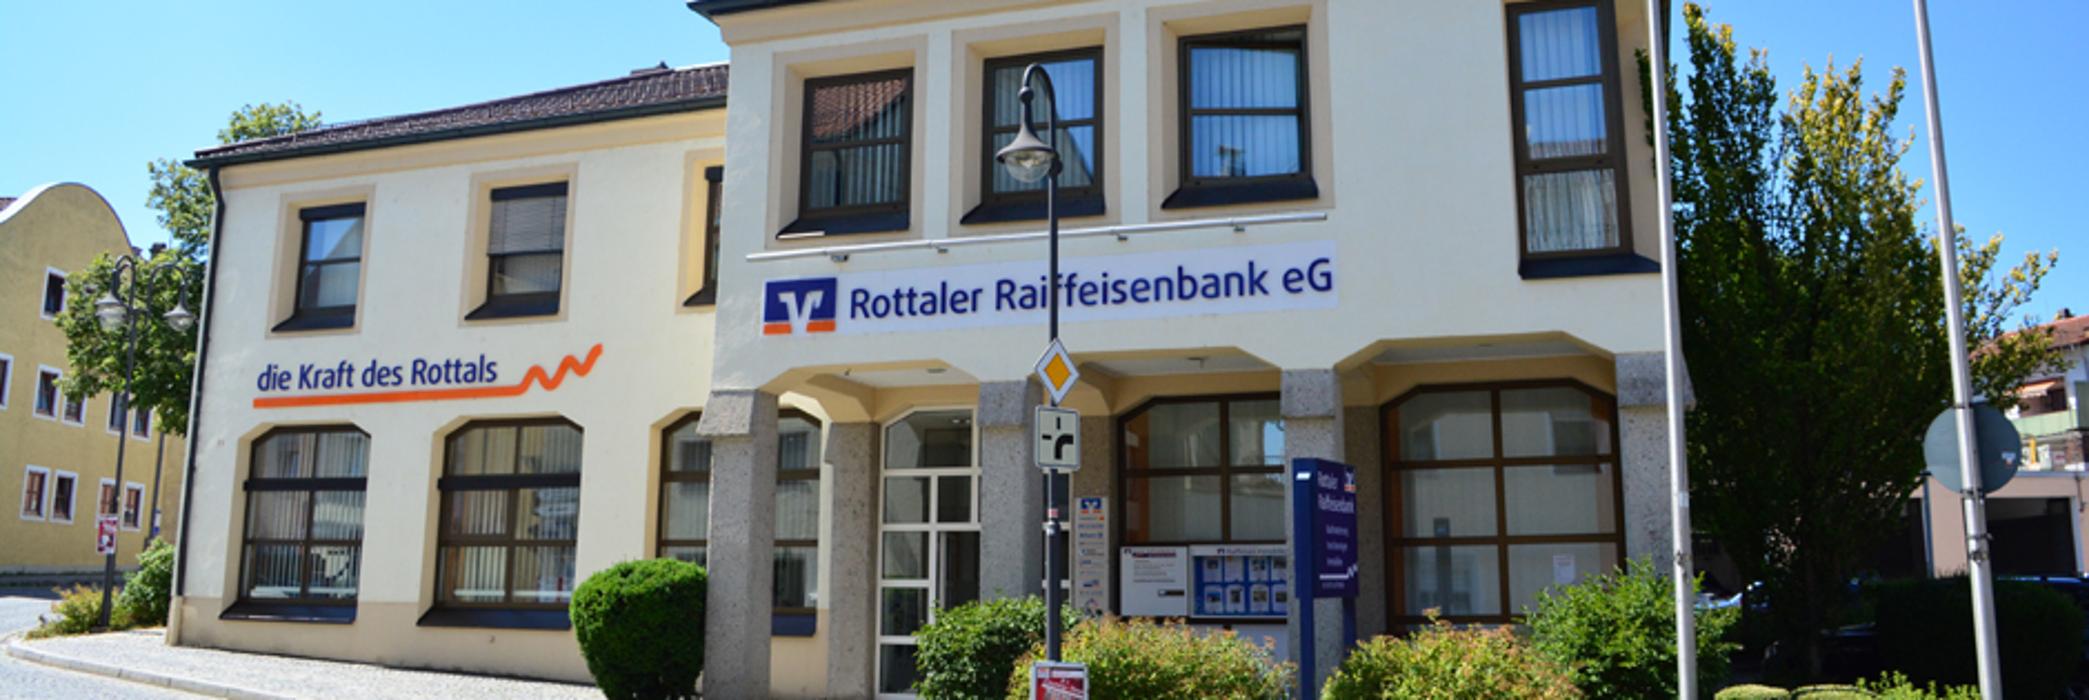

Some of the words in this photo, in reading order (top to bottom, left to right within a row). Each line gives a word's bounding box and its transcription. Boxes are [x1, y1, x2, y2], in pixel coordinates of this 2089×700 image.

[849, 281, 984, 320] Rottaler
[1281, 257, 1333, 294] eG
[257, 363, 292, 391] die
[298, 360, 354, 389] Kraft
[361, 359, 403, 387] des
[410, 354, 497, 385] Rottals
